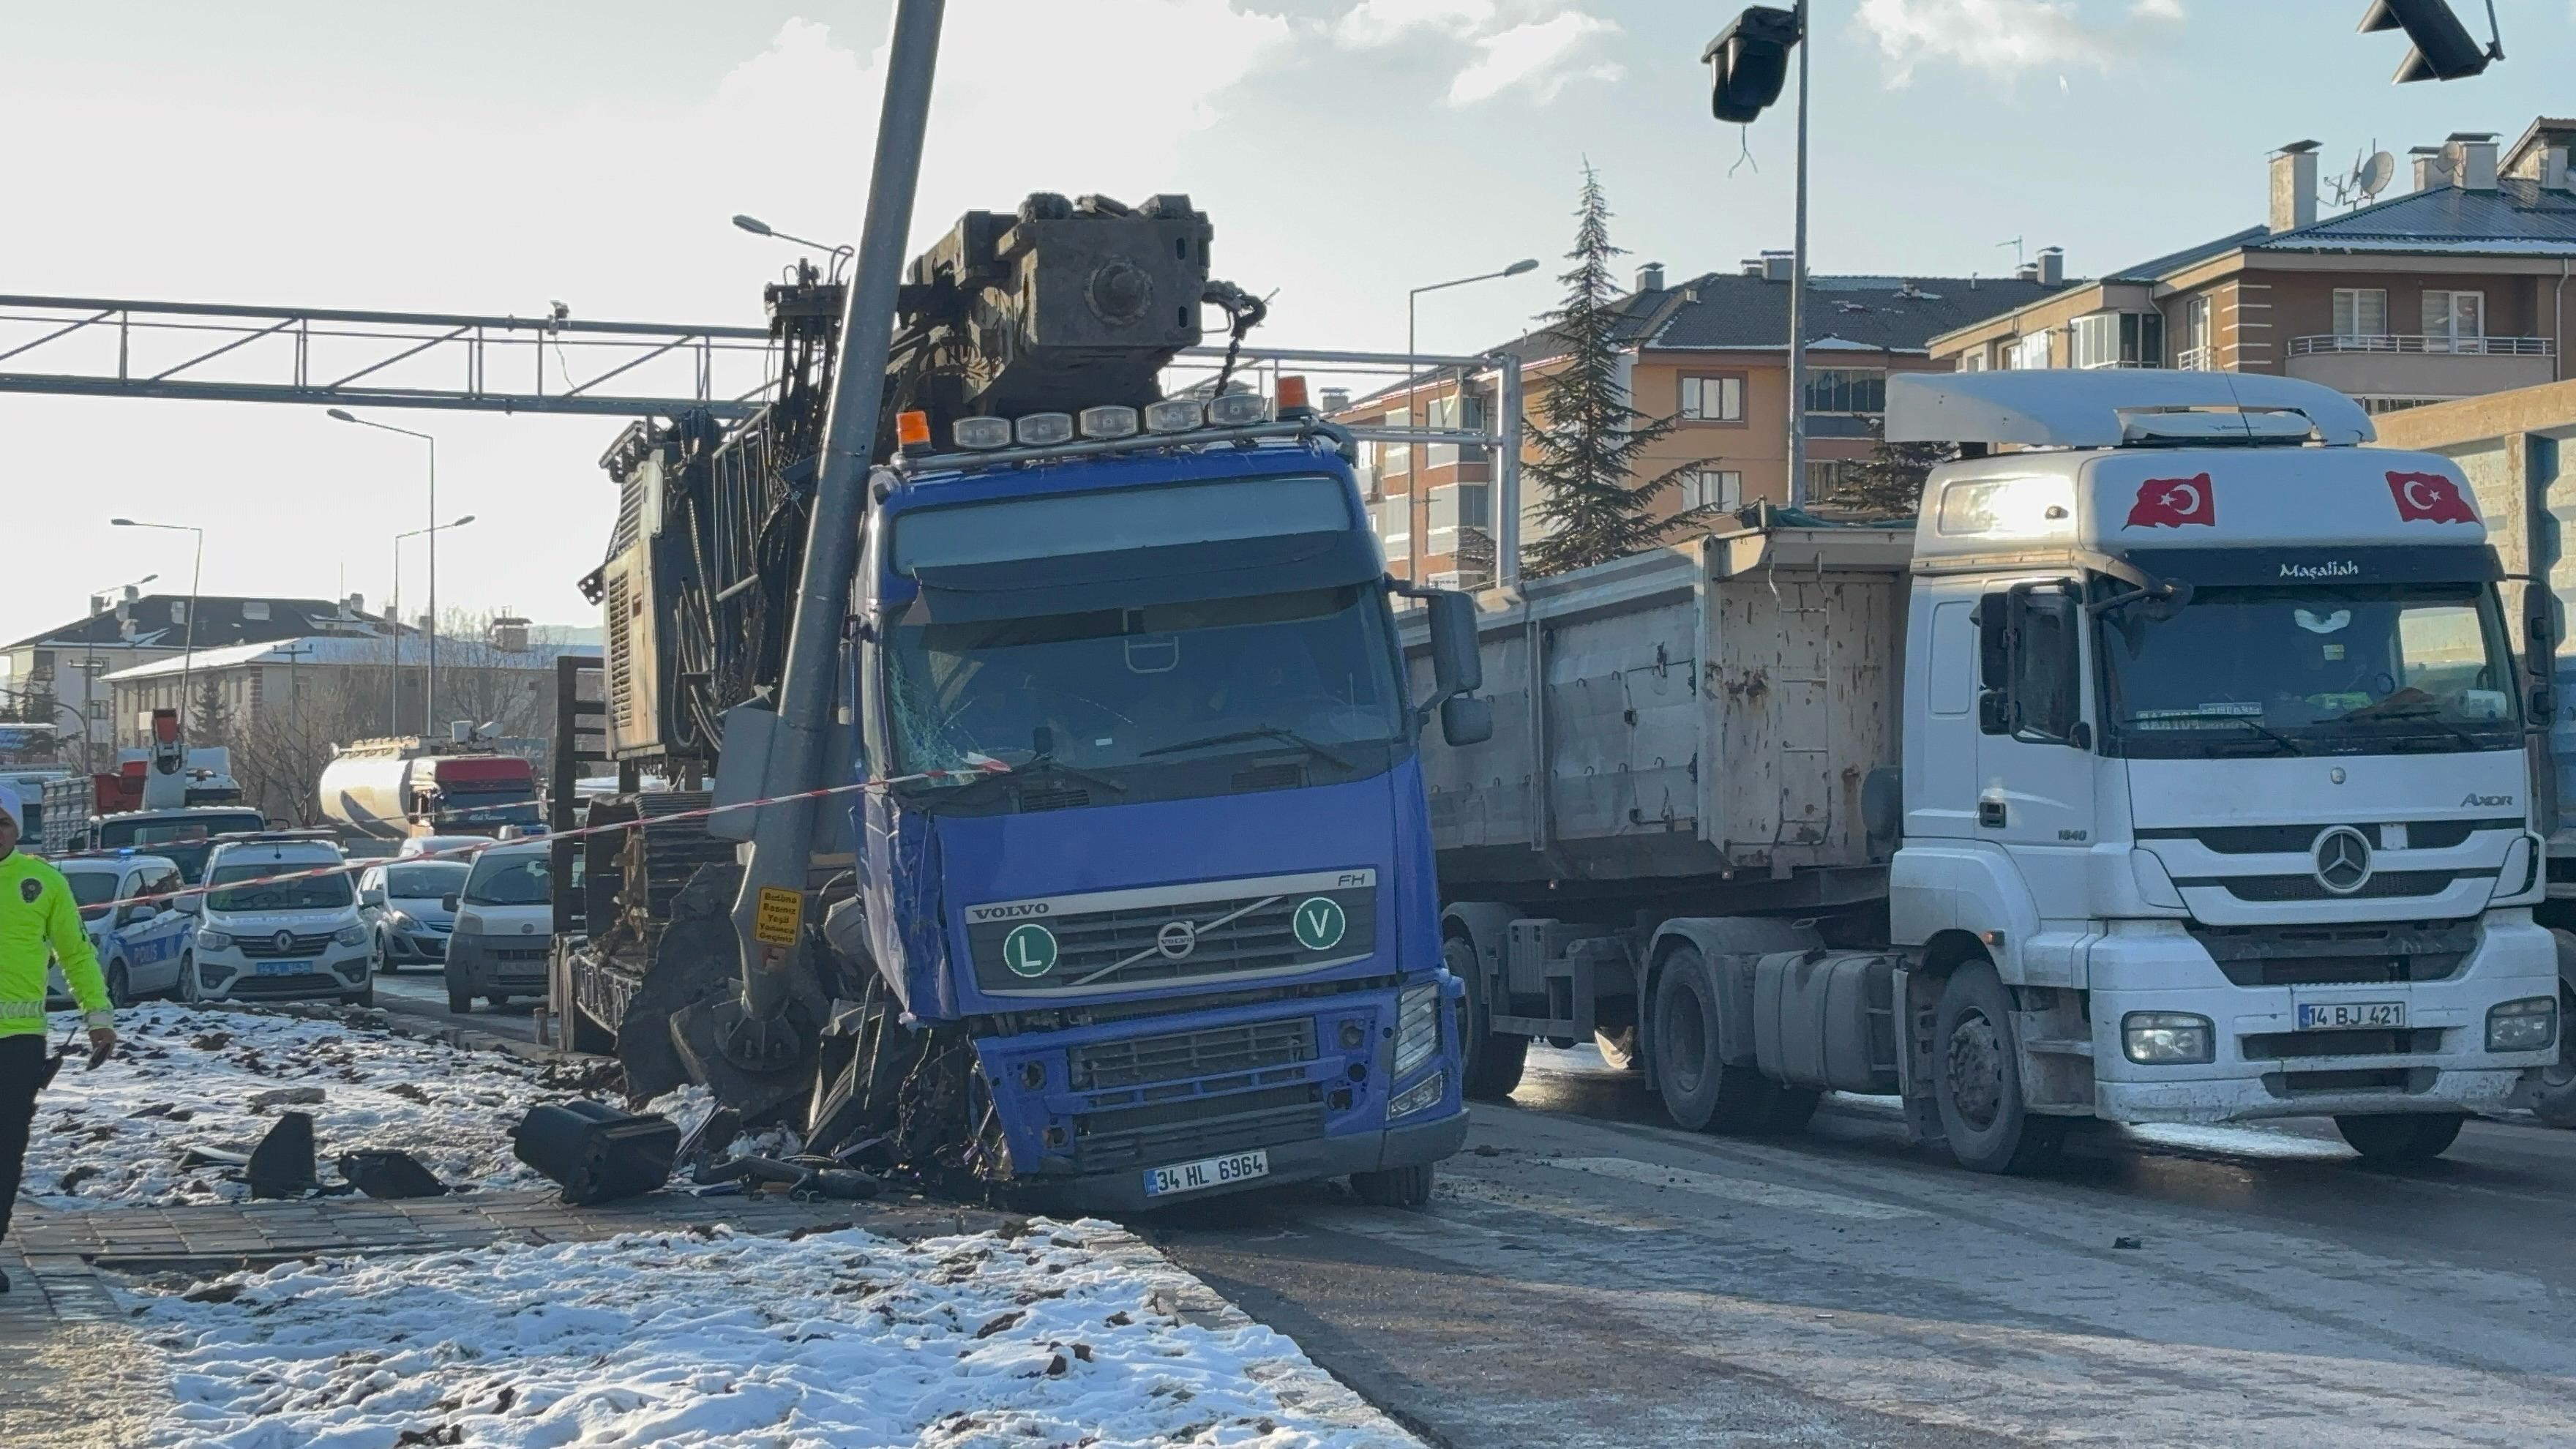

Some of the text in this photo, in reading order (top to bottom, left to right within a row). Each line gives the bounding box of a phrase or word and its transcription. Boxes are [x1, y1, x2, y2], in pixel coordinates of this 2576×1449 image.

[1338, 873, 1366, 887] FH
[972, 903, 1049, 919] VOLVO
[1307, 908, 1330, 938] V
[1019, 935, 1042, 967] L
[2310, 1006, 2400, 1025] 14 BJ 421
[1157, 1155, 1263, 1191] 34 HL 6964
